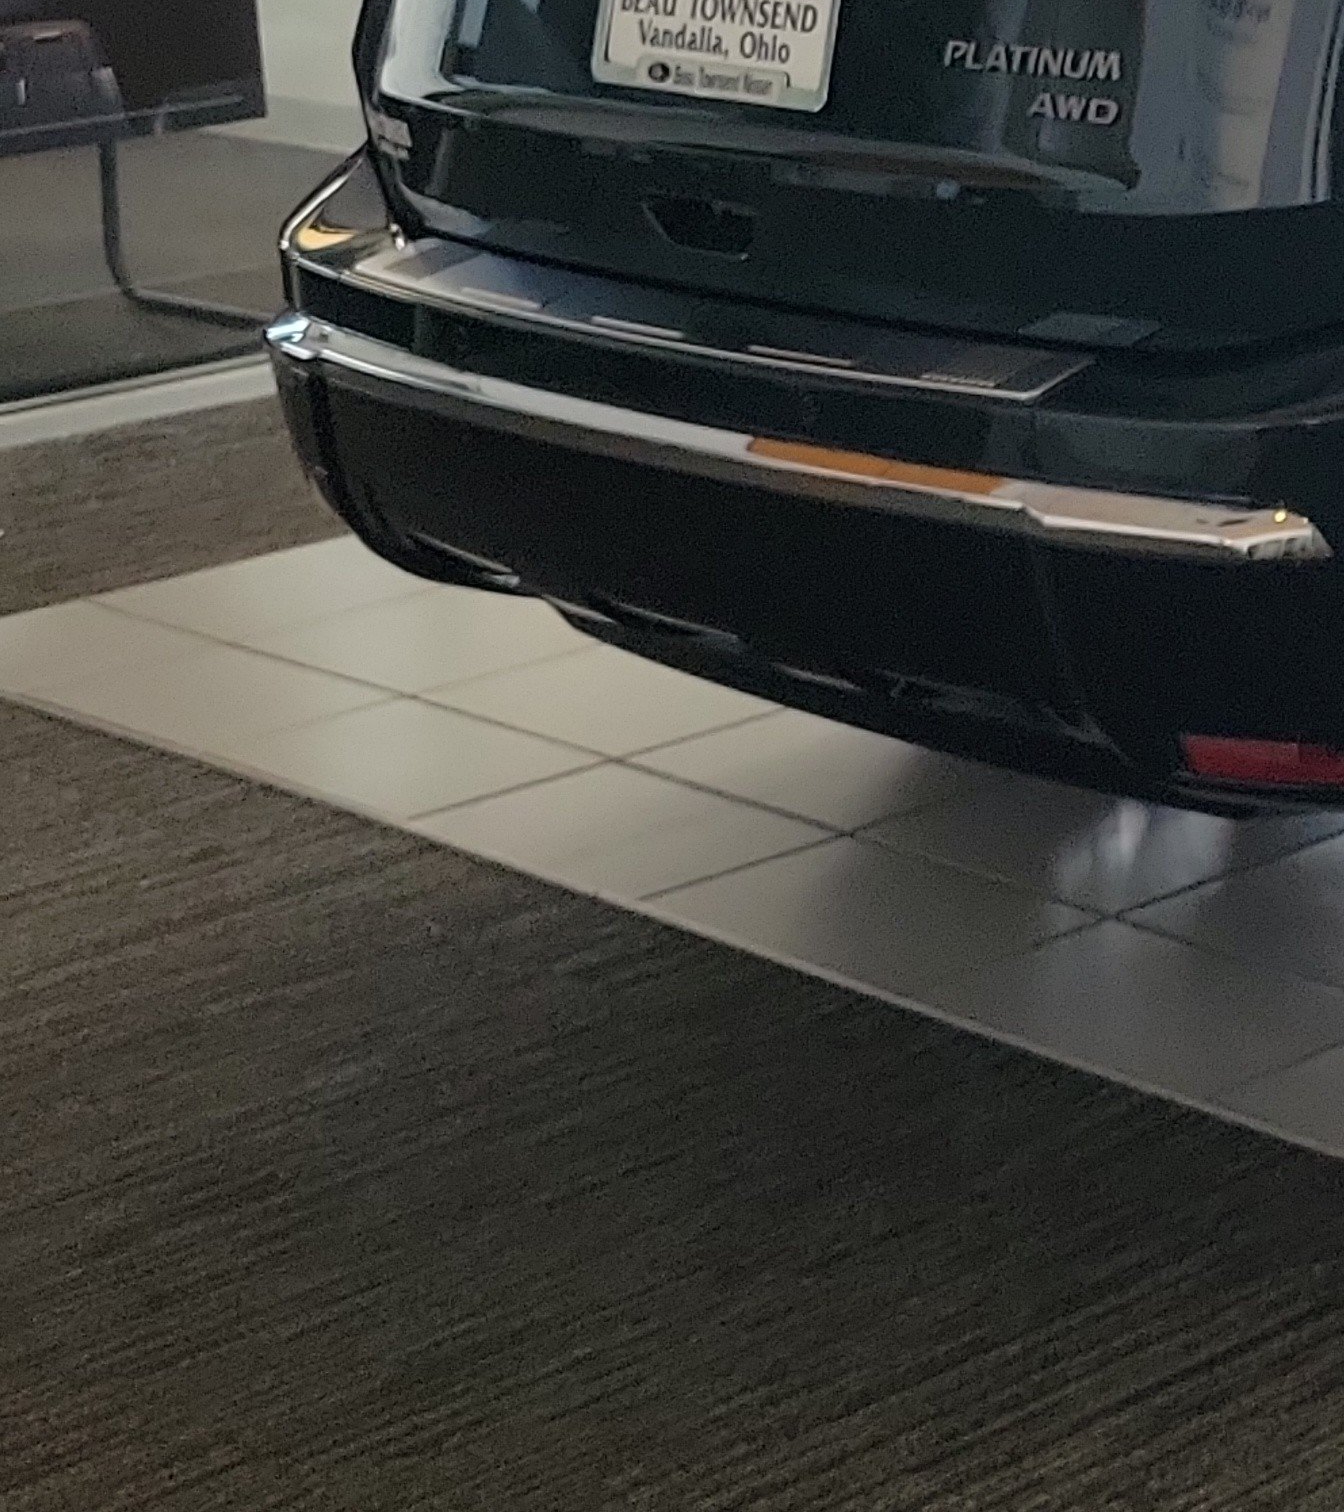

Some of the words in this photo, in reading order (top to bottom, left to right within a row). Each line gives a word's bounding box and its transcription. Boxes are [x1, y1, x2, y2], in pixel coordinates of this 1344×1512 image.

[739, 30, 791, 64] Ohio
[943, 39, 1121, 82] PLATINUM
[1028, 91, 1120, 125] AWD
